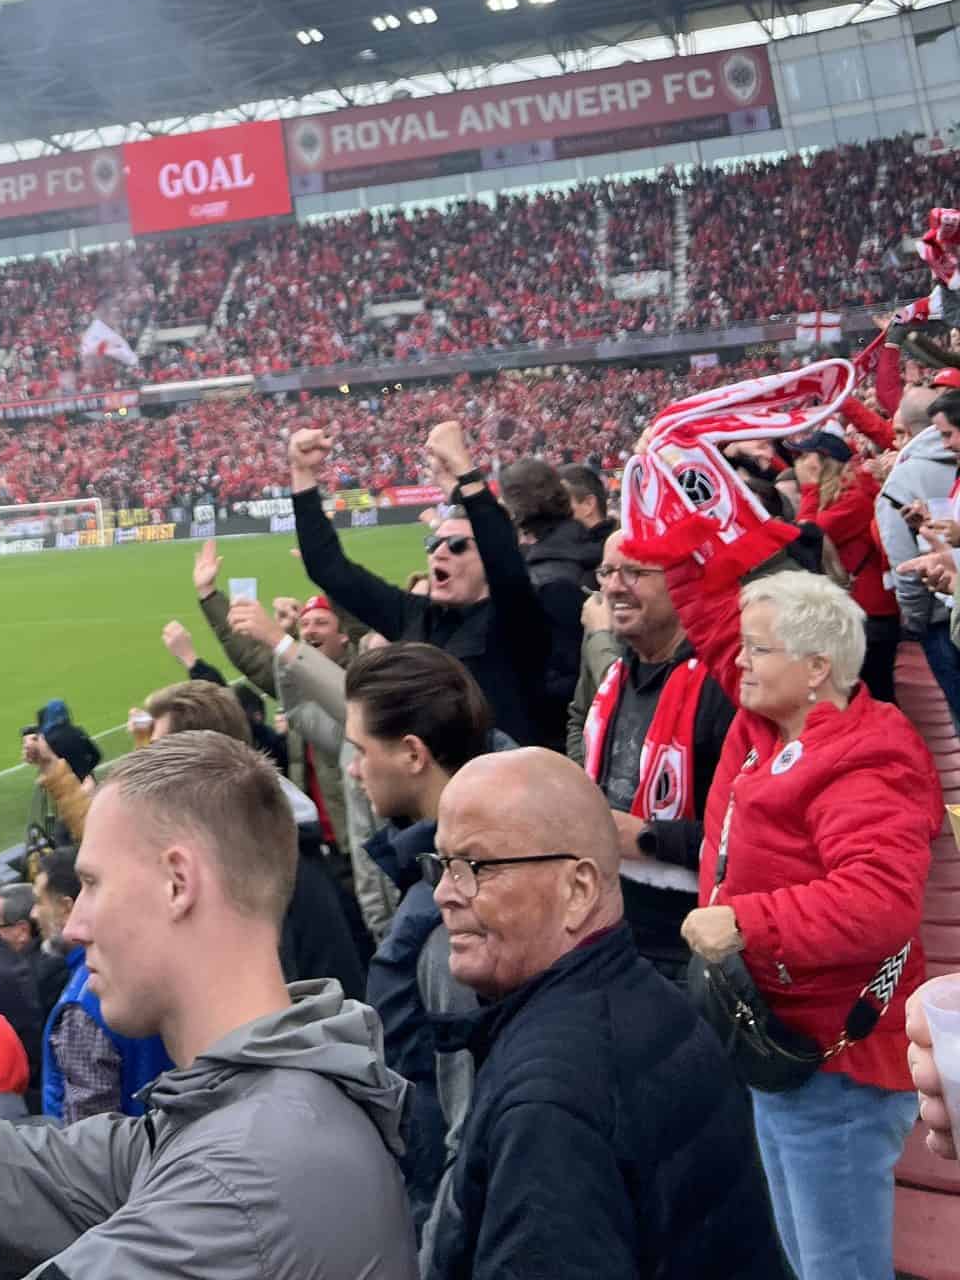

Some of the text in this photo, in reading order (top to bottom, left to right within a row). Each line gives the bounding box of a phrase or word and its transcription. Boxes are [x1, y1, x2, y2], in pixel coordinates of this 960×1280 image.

[330, 68, 716, 154] ROYAL ANTWERP FC
[46, 167, 86, 196] FC
[158, 153, 255, 199] GOAL
